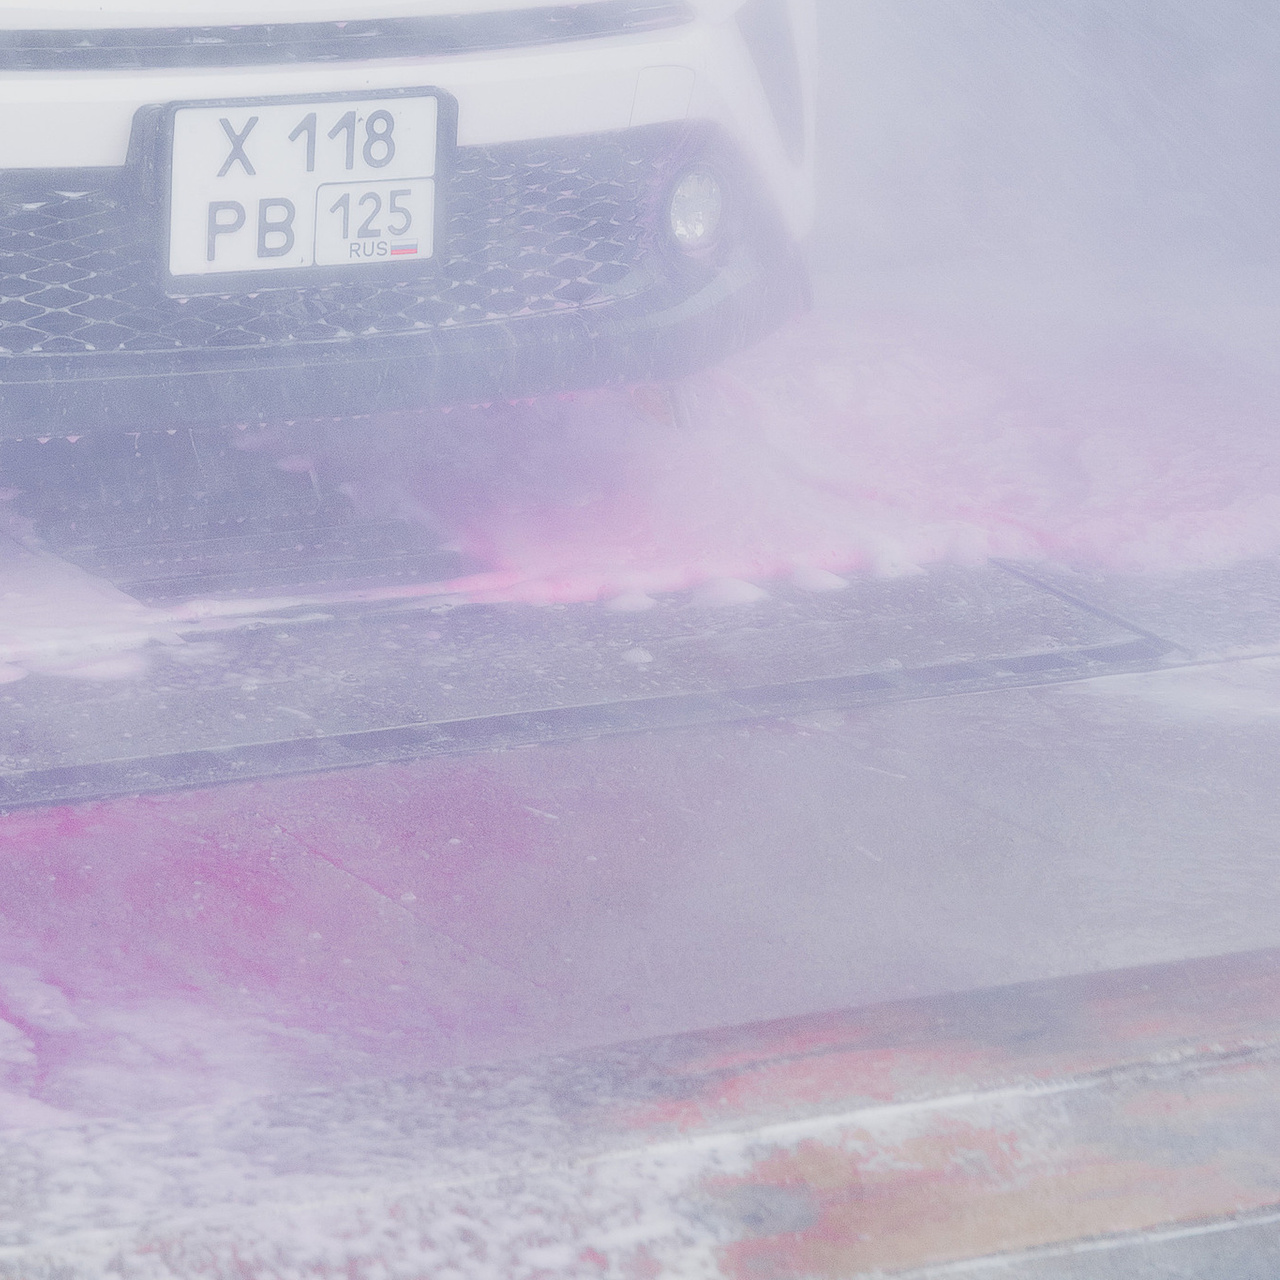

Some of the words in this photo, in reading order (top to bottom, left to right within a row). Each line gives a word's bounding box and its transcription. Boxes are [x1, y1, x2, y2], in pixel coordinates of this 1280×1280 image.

[288, 108, 396, 173] 118
[329, 188, 413, 240] 125
[349, 240, 388, 259] RUS
